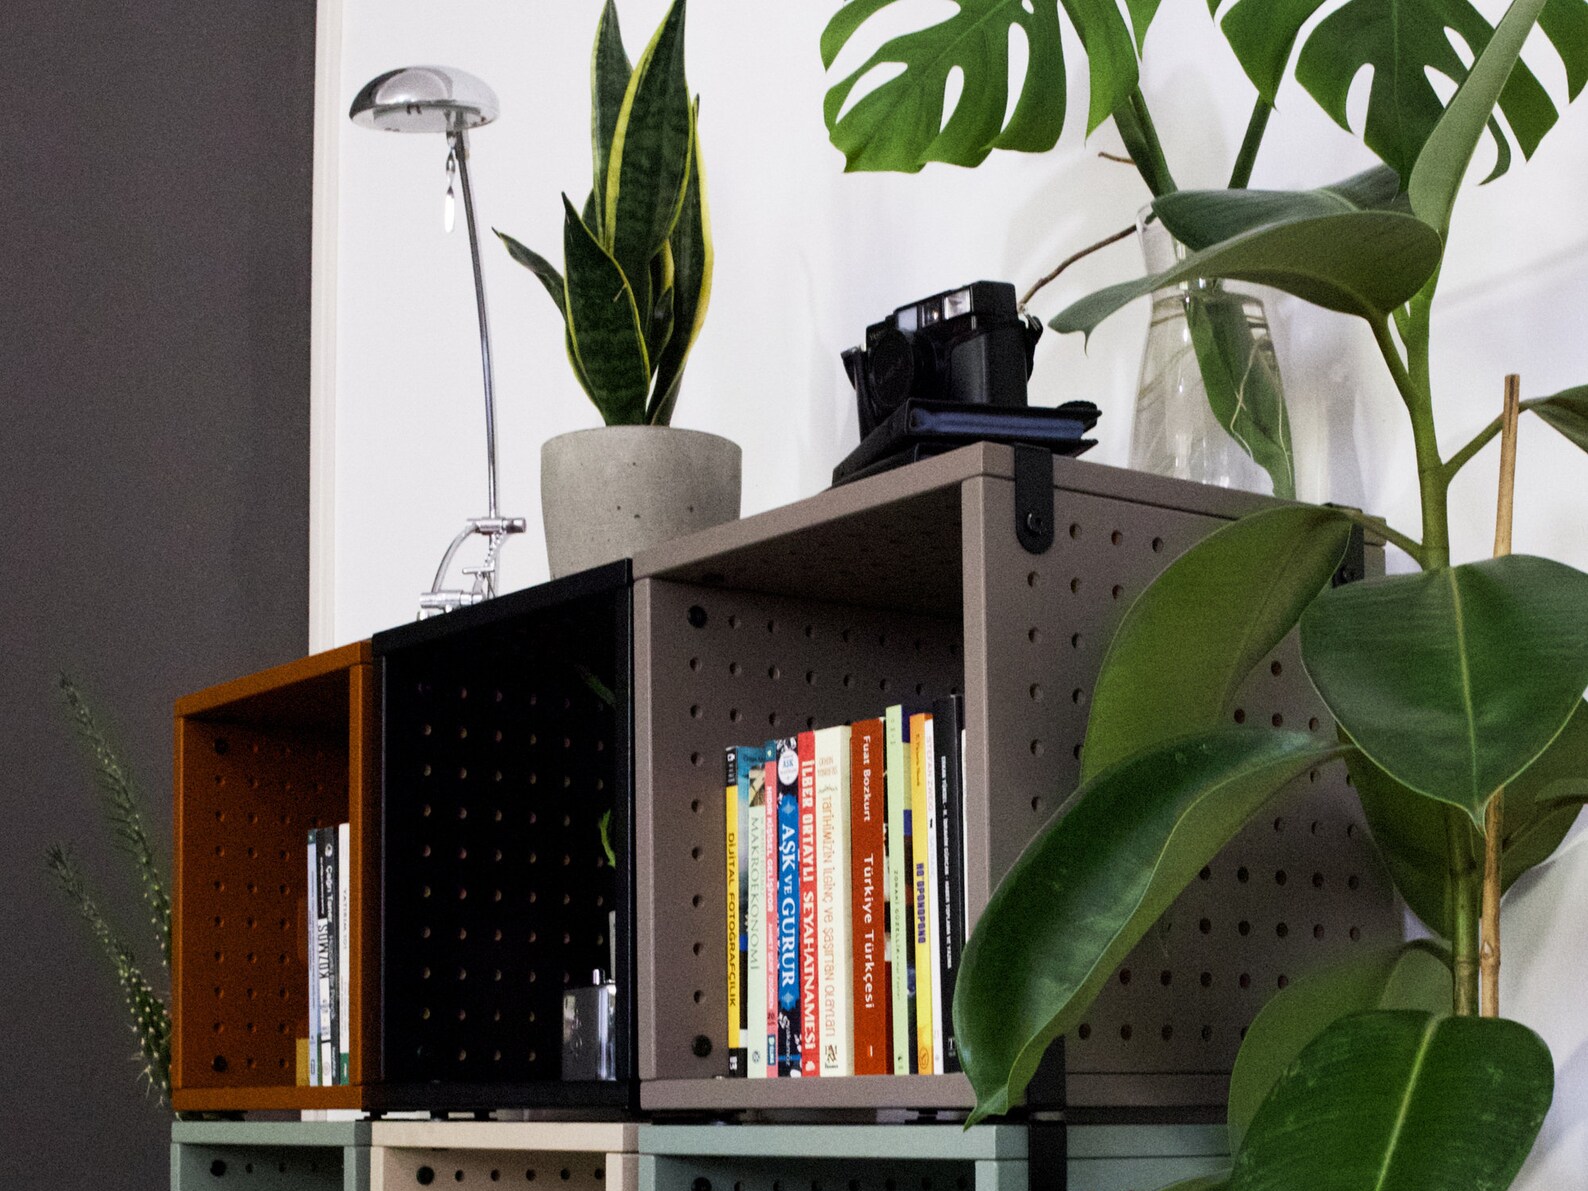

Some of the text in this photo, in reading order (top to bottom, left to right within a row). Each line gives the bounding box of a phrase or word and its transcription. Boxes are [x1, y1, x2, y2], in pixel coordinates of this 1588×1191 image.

[802, 760, 815, 808] İLBER
[863, 736, 872, 821] Fuat Bozkurt
[750, 817, 760, 970] MAKROEKONOMİ
[779, 824, 796, 986] AŞK VE GURUR
[802, 814, 814, 881] ORTAYLI
[318, 925, 329, 979] KOZMOS
[728, 833, 738, 1006] DİJİTAL FOTOĞRAFÇILIK
[863, 854, 876, 1008] Türkiye Türkçesi
